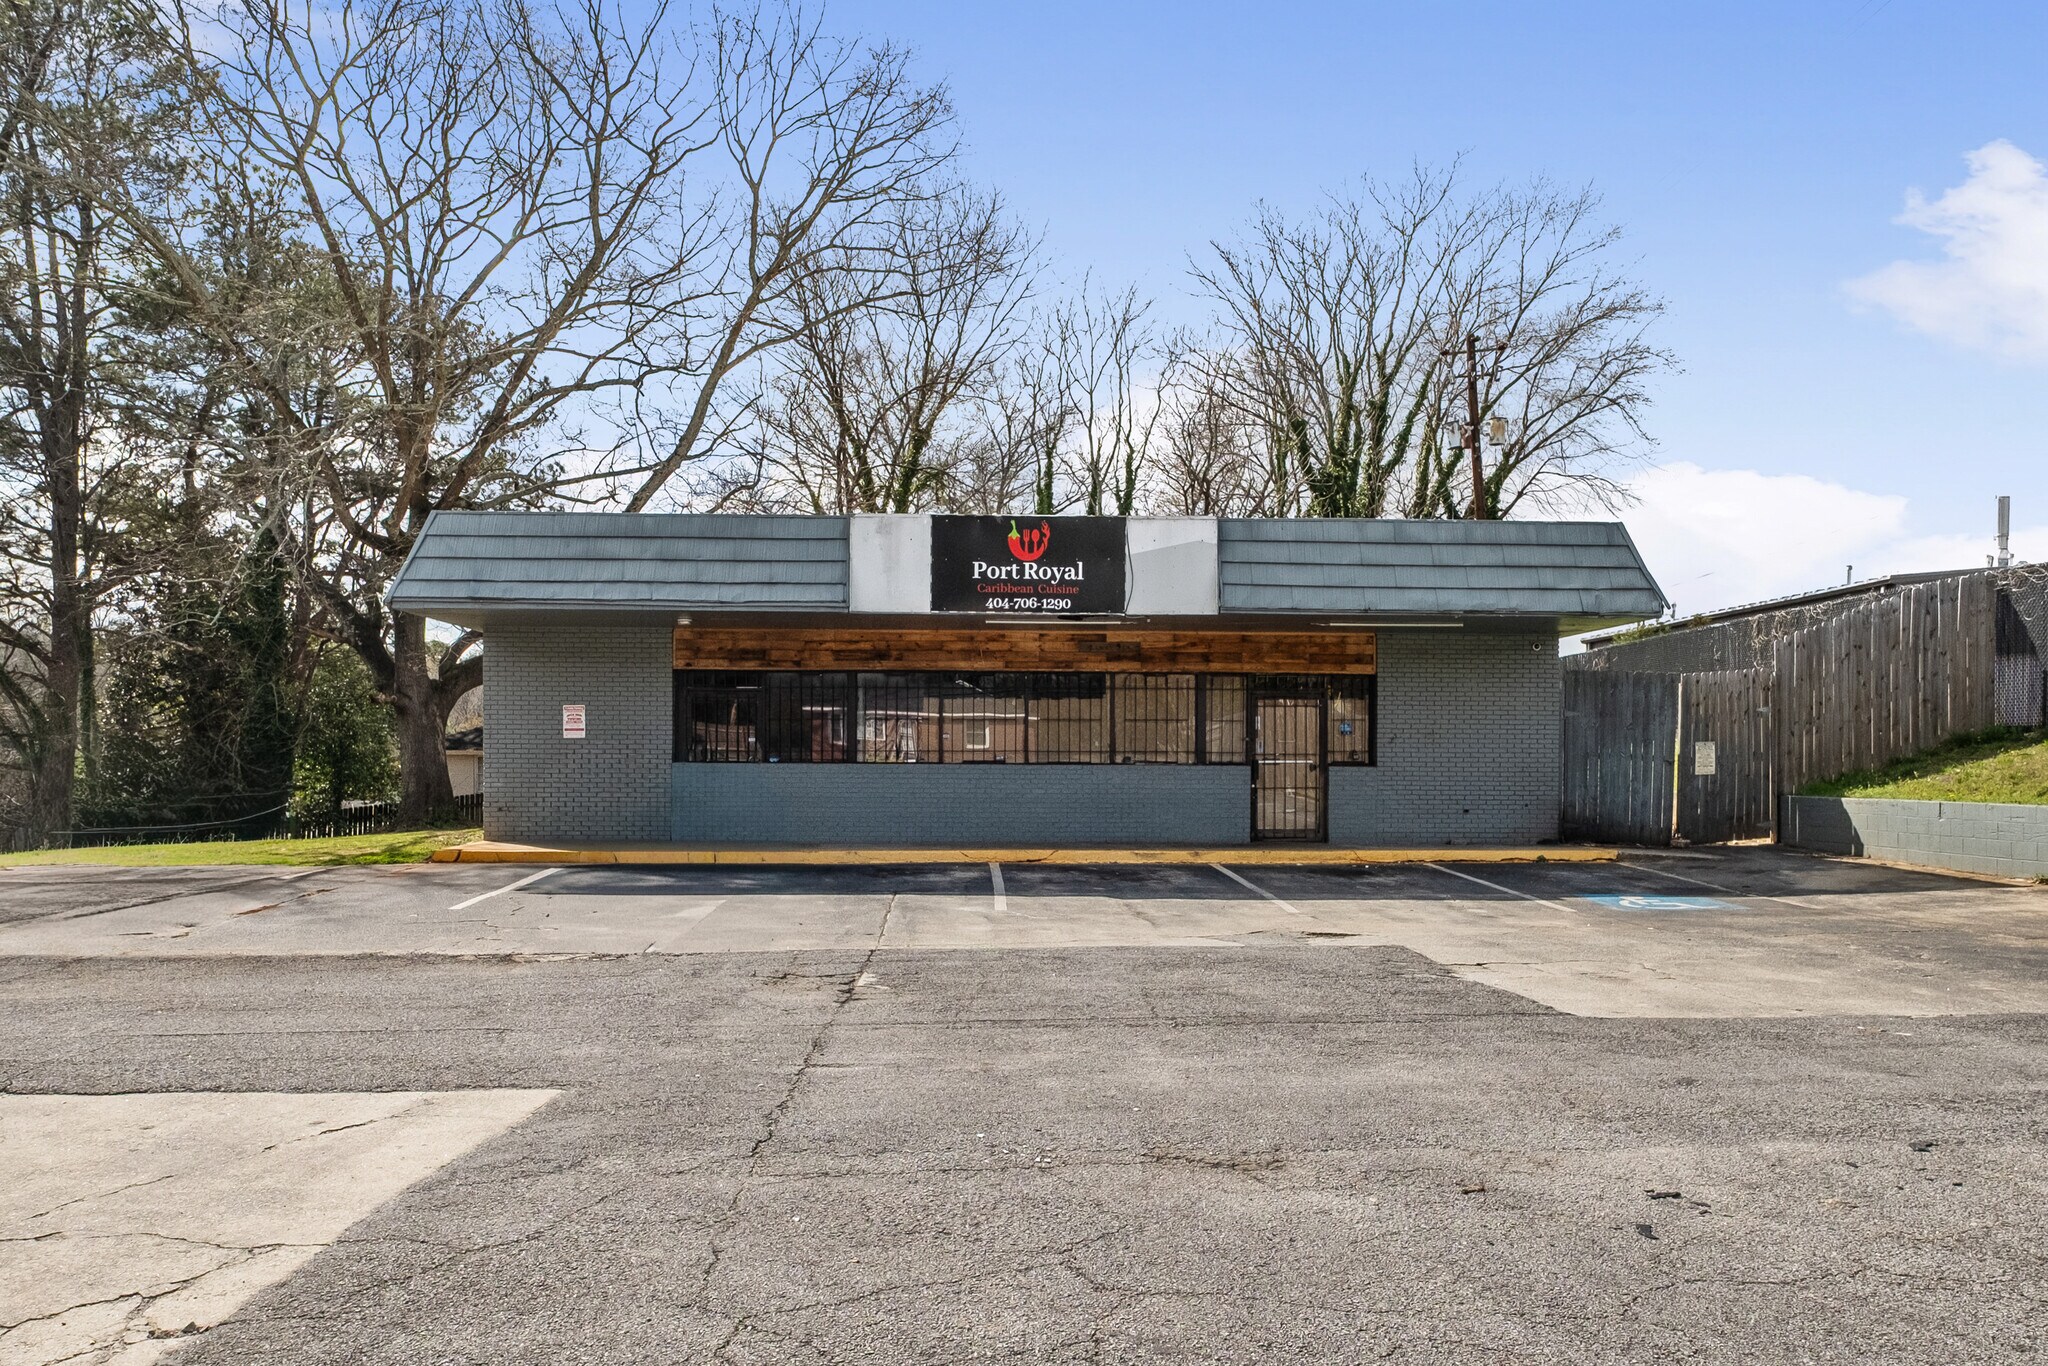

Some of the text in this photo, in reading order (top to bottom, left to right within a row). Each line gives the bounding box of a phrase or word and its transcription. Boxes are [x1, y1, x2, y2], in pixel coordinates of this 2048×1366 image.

[972, 561, 1084, 584] Port Royal
[977, 583, 1079, 594] Caribbean Cuisine
[985, 598, 1071, 609] 404-706-1290
